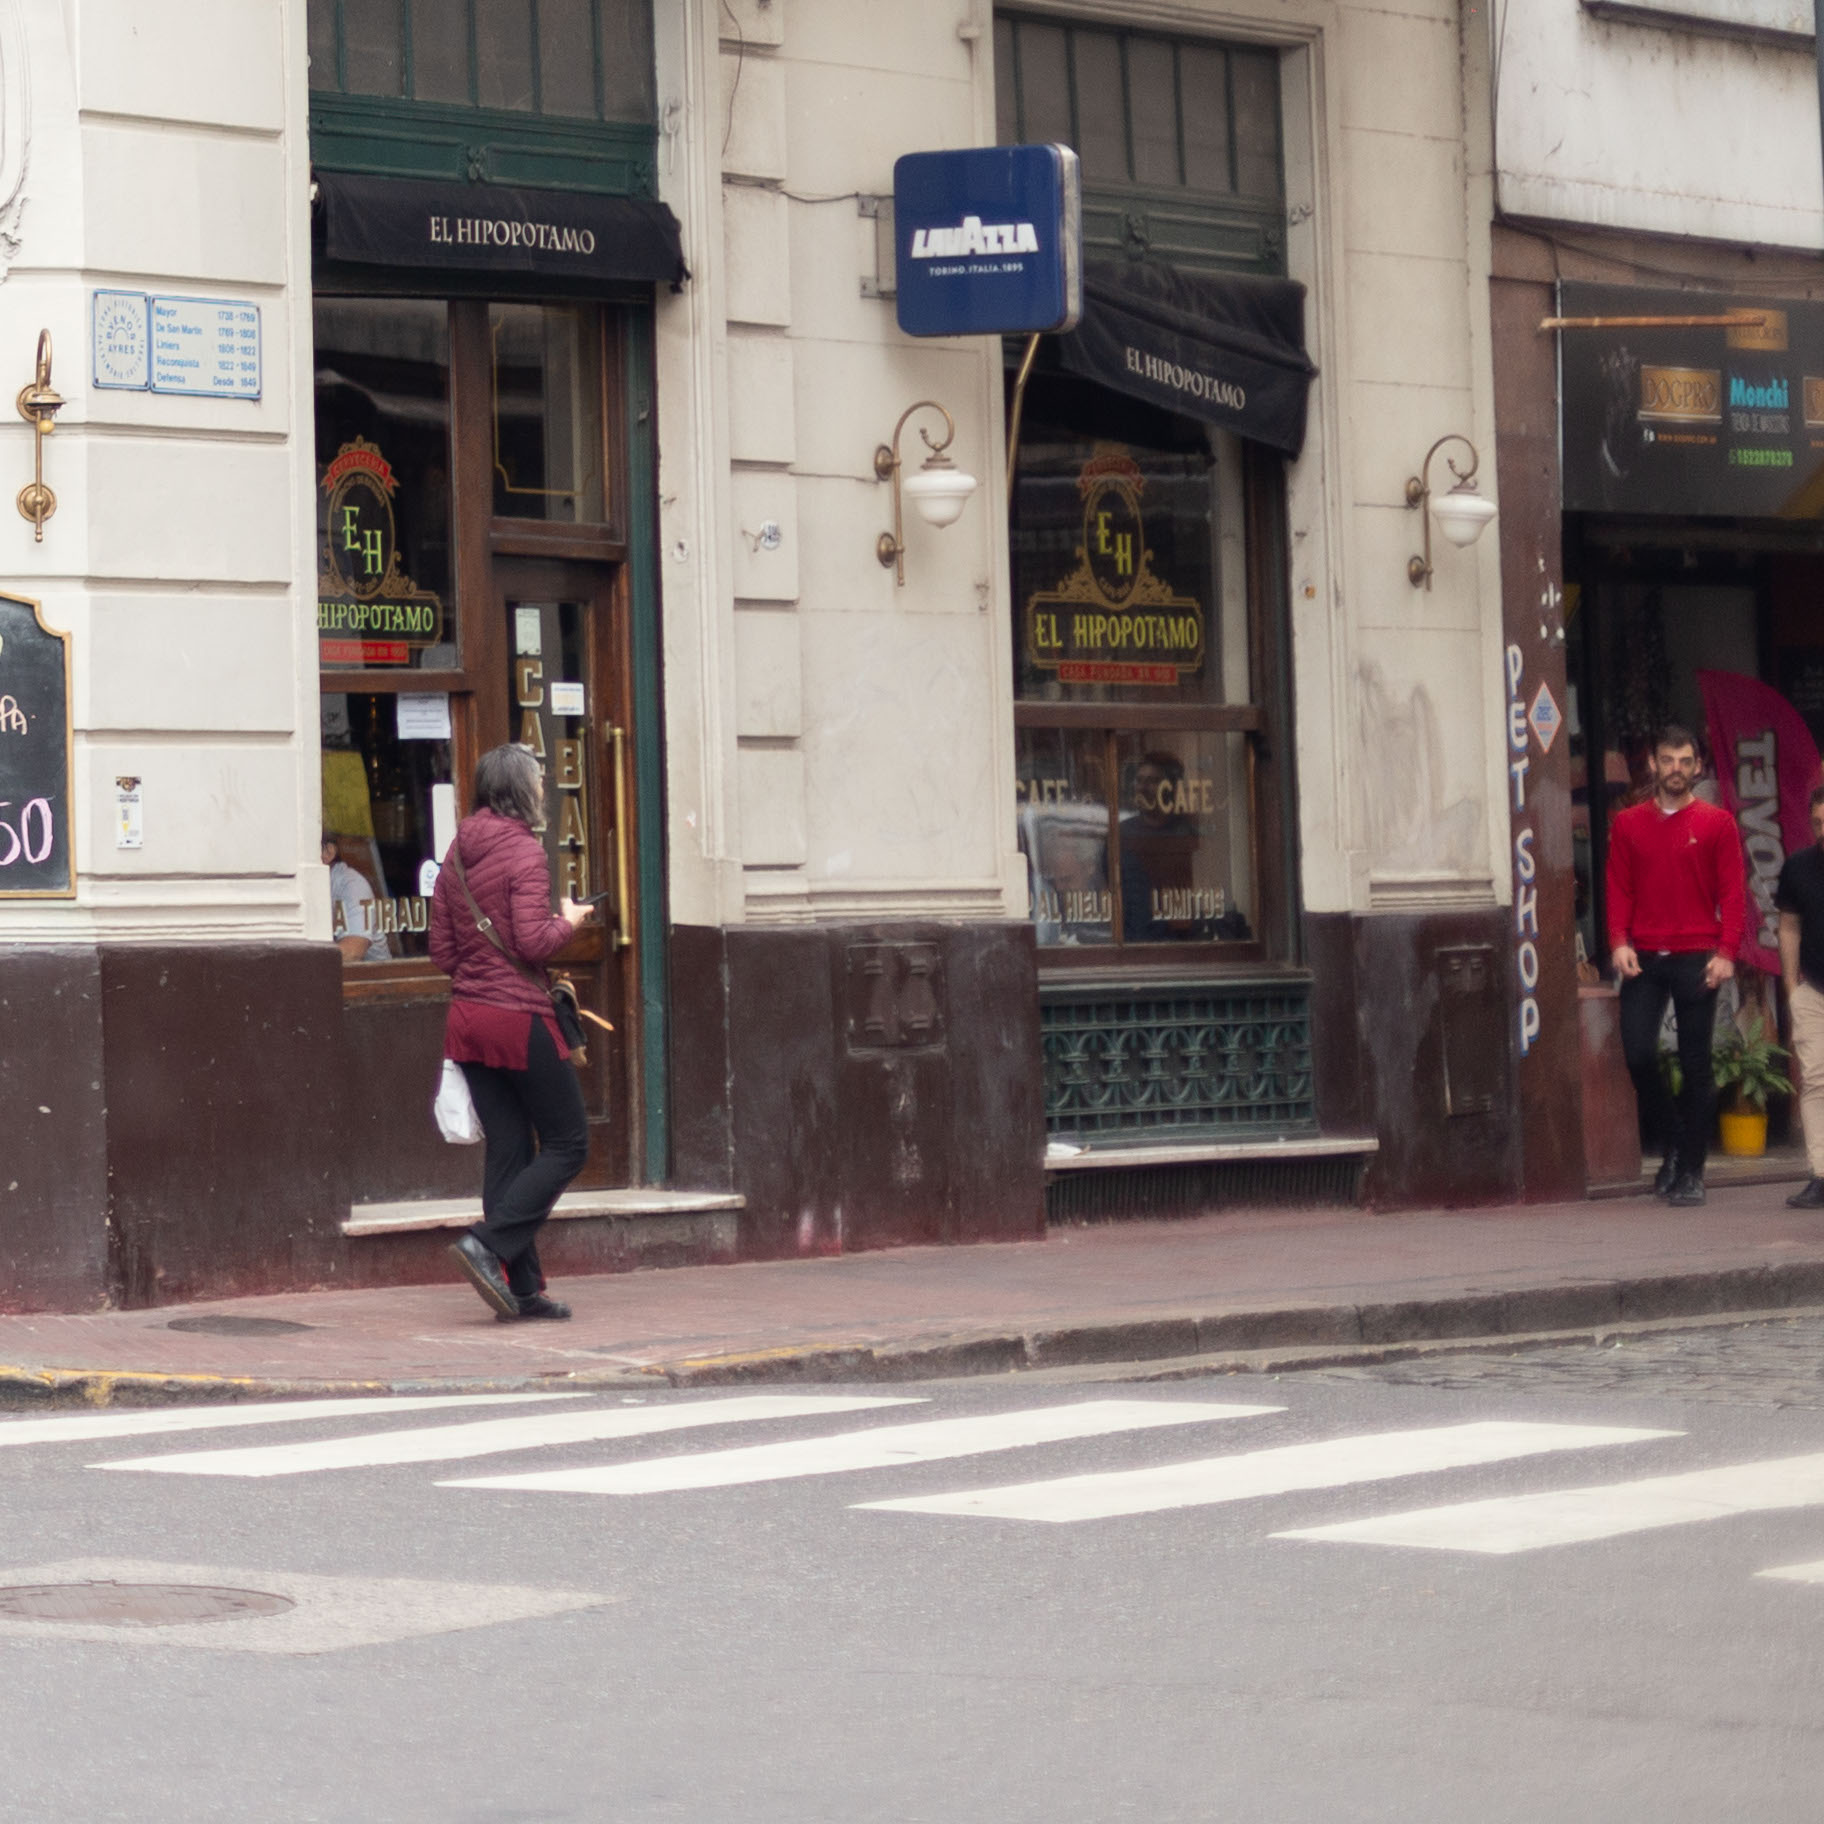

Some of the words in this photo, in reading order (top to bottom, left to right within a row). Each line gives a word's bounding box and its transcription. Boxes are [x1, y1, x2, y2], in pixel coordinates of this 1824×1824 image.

[430, 216, 452, 244] EL
[457, 217, 595, 255] HIPOPOTAMO
[911, 216, 1039, 258] LAVAZZA
[156, 306, 177, 318] Mayor
[156, 323, 166, 332] De
[167, 324, 179, 334] San
[108, 344, 135, 355] AYRES
[157, 356, 200, 368] Reconquista
[213, 376, 234, 386] Desde
[1126, 346, 1143, 375] EL
[1146, 352, 1246, 410] HIPOPOTAMO
[317, 603, 434, 633] HIPOPOTAMO
[1035, 613, 1062, 649] EL
[1073, 614, 1199, 649] HIPOPOTAMO
[359, 897, 432, 933] TIRAD
